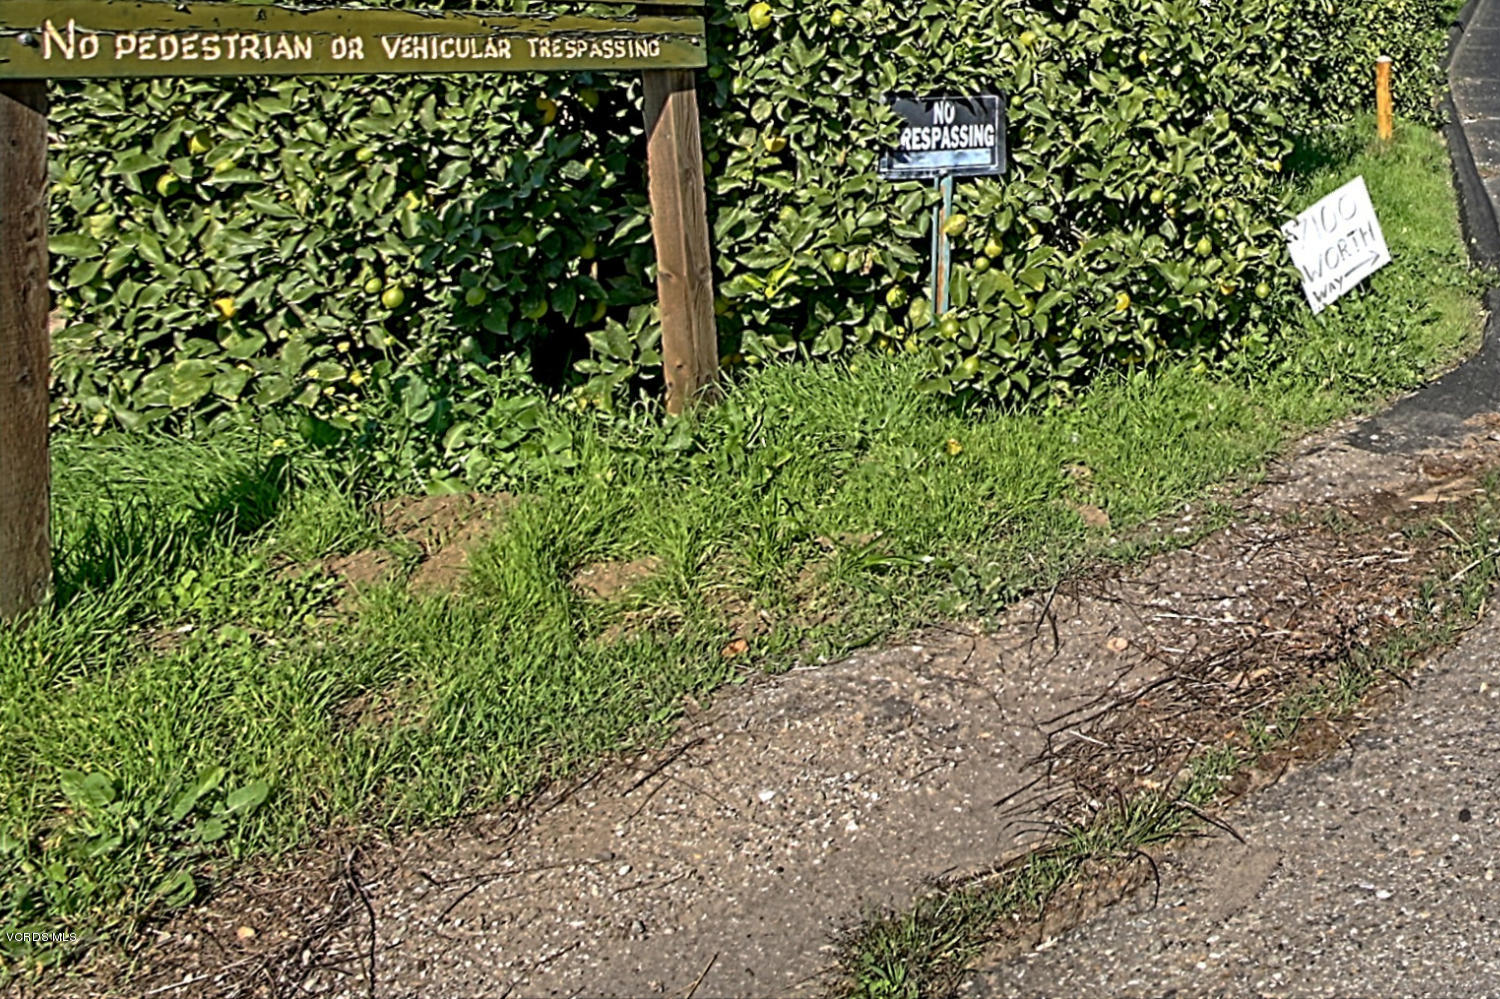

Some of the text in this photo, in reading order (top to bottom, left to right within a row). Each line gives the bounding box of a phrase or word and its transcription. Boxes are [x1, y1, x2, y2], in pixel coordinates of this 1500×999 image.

[115, 32, 312, 60] PEDESTRIAN
[331, 35, 365, 61] OR
[381, 34, 512, 60] VEHICULAR
[527, 35, 661, 59] TRESPASSING
[933, 101, 956, 125] NO
[900, 124, 995, 150] RESPASSING
[1302, 220, 1376, 283] WORTH
[1312, 275, 1344, 303] WAY
